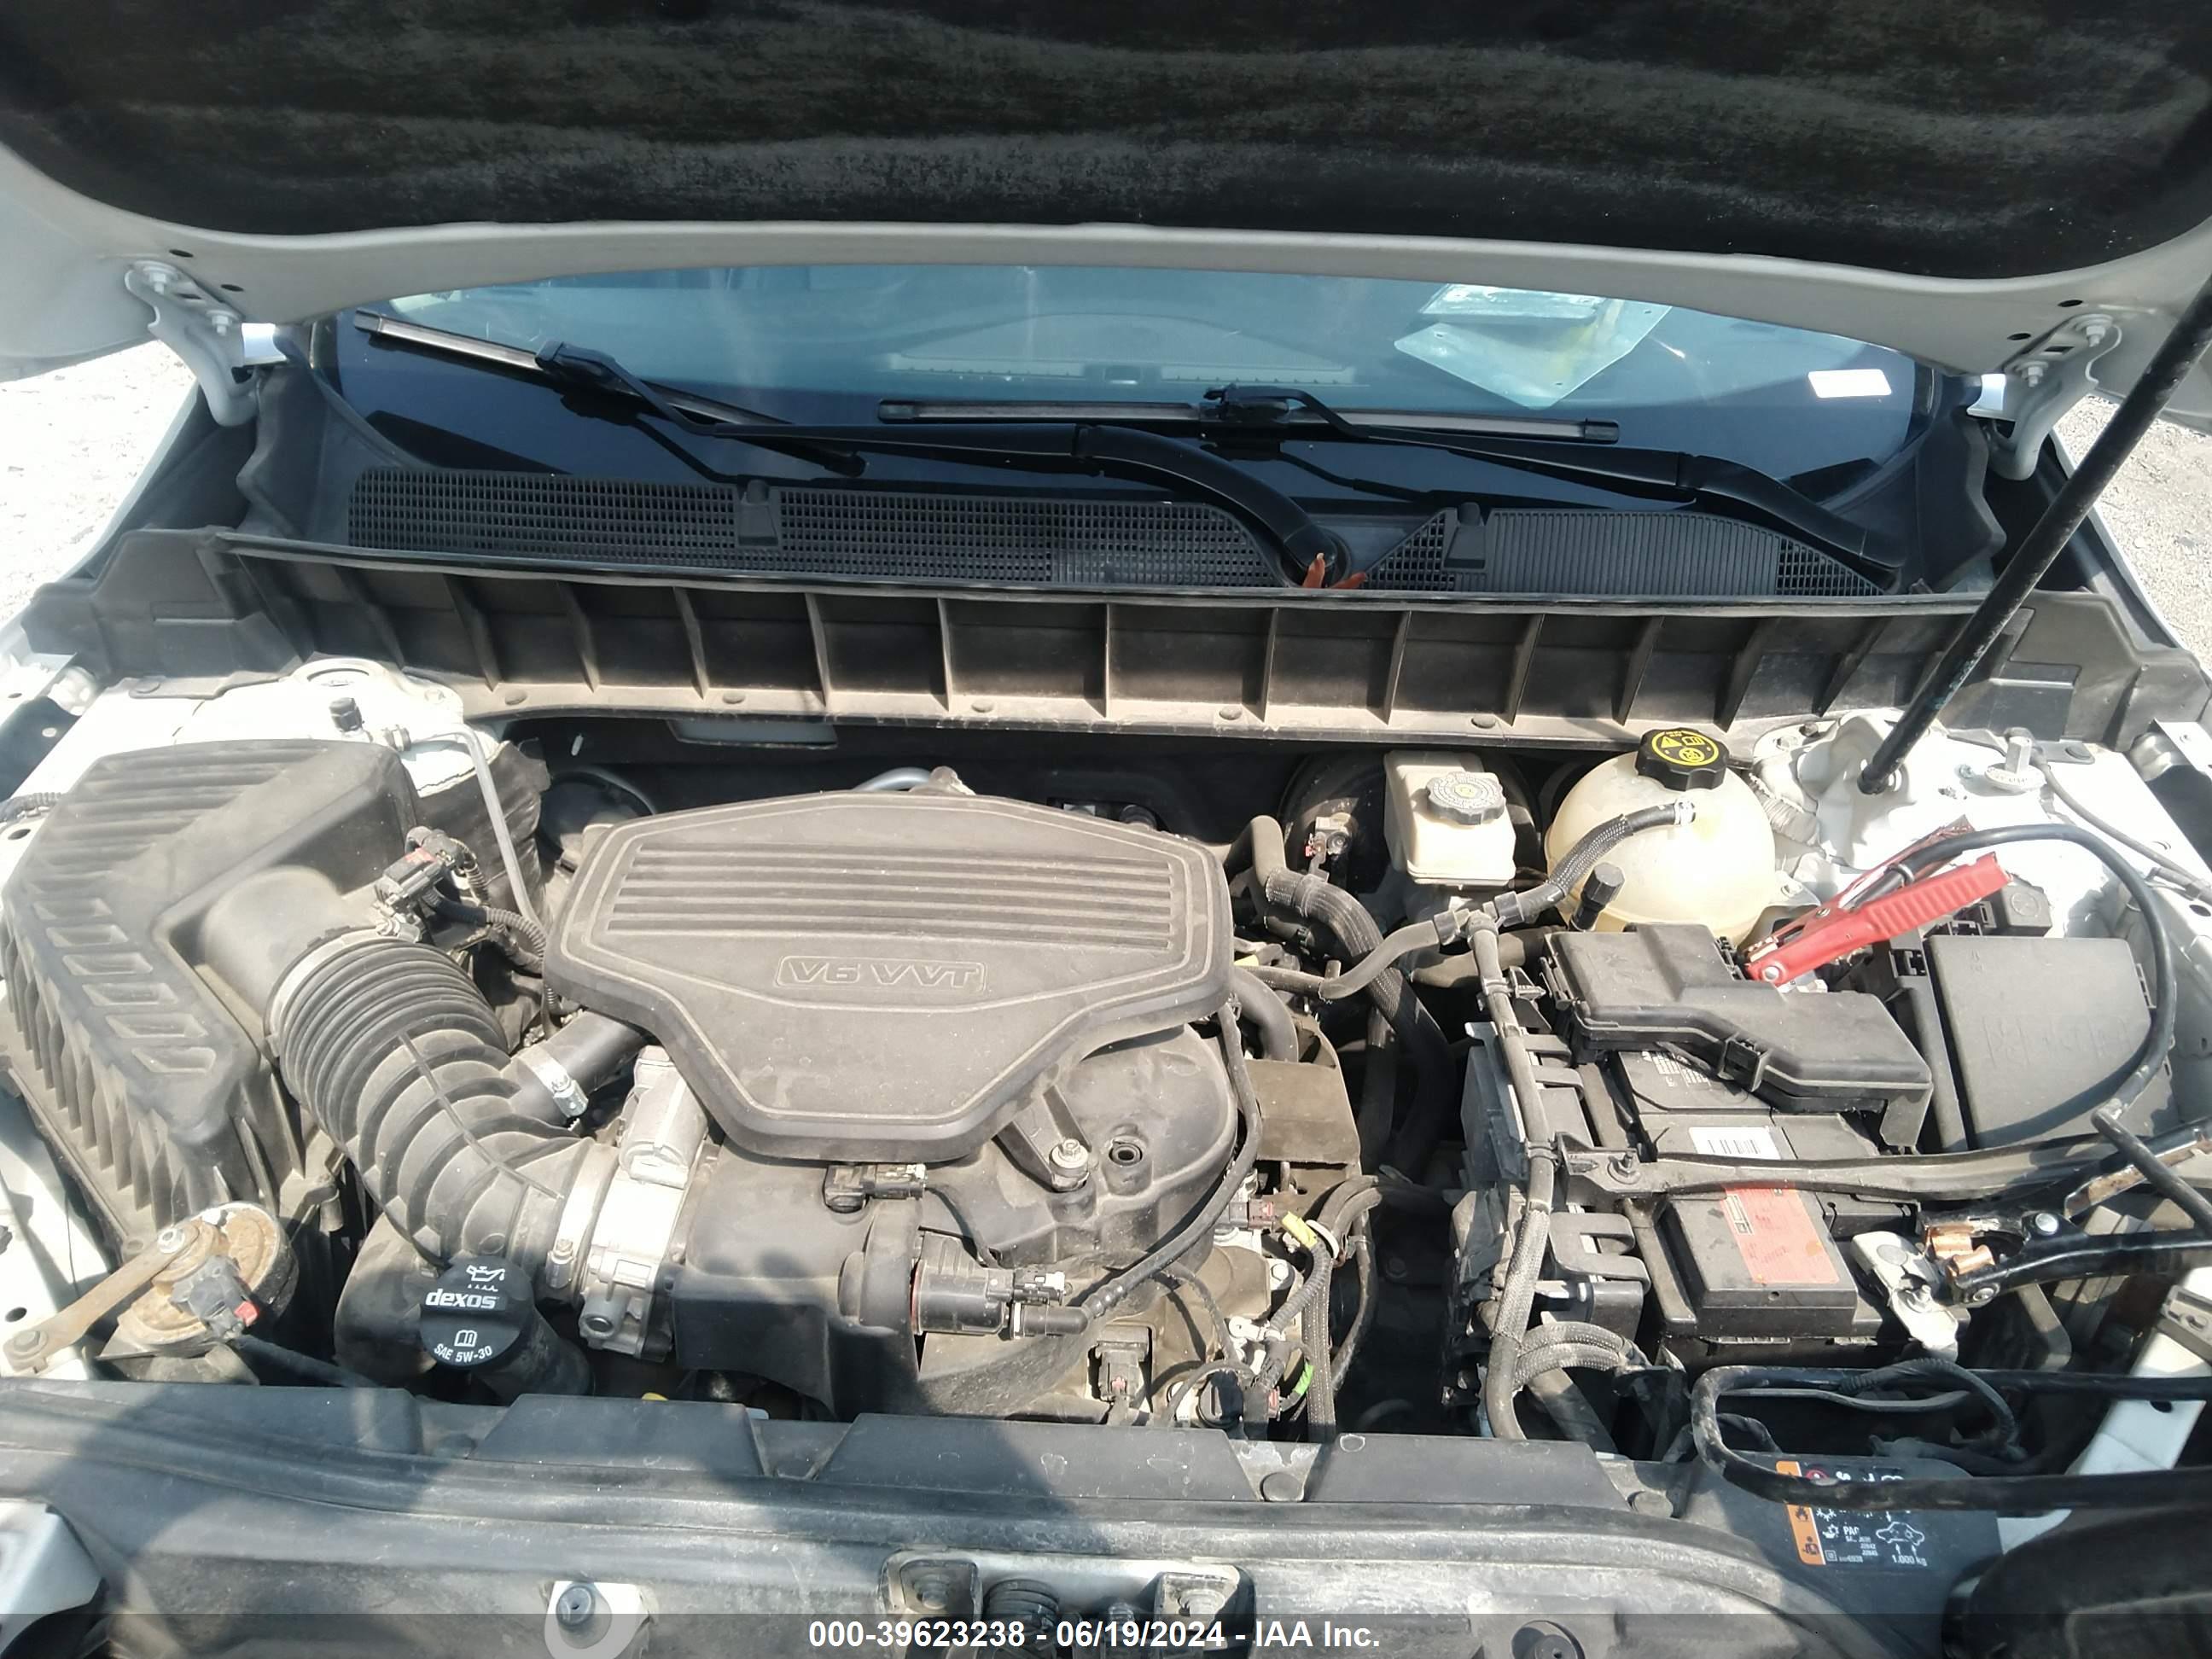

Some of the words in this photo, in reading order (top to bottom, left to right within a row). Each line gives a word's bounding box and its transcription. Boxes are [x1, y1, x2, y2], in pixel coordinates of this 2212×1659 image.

[788, 962, 862, 983] V6
[870, 963, 980, 988] VVT
[425, 1289, 498, 1309] dexos
[434, 1343, 454, 1360] SAE
[455, 1345, 493, 1363] 5W-30
